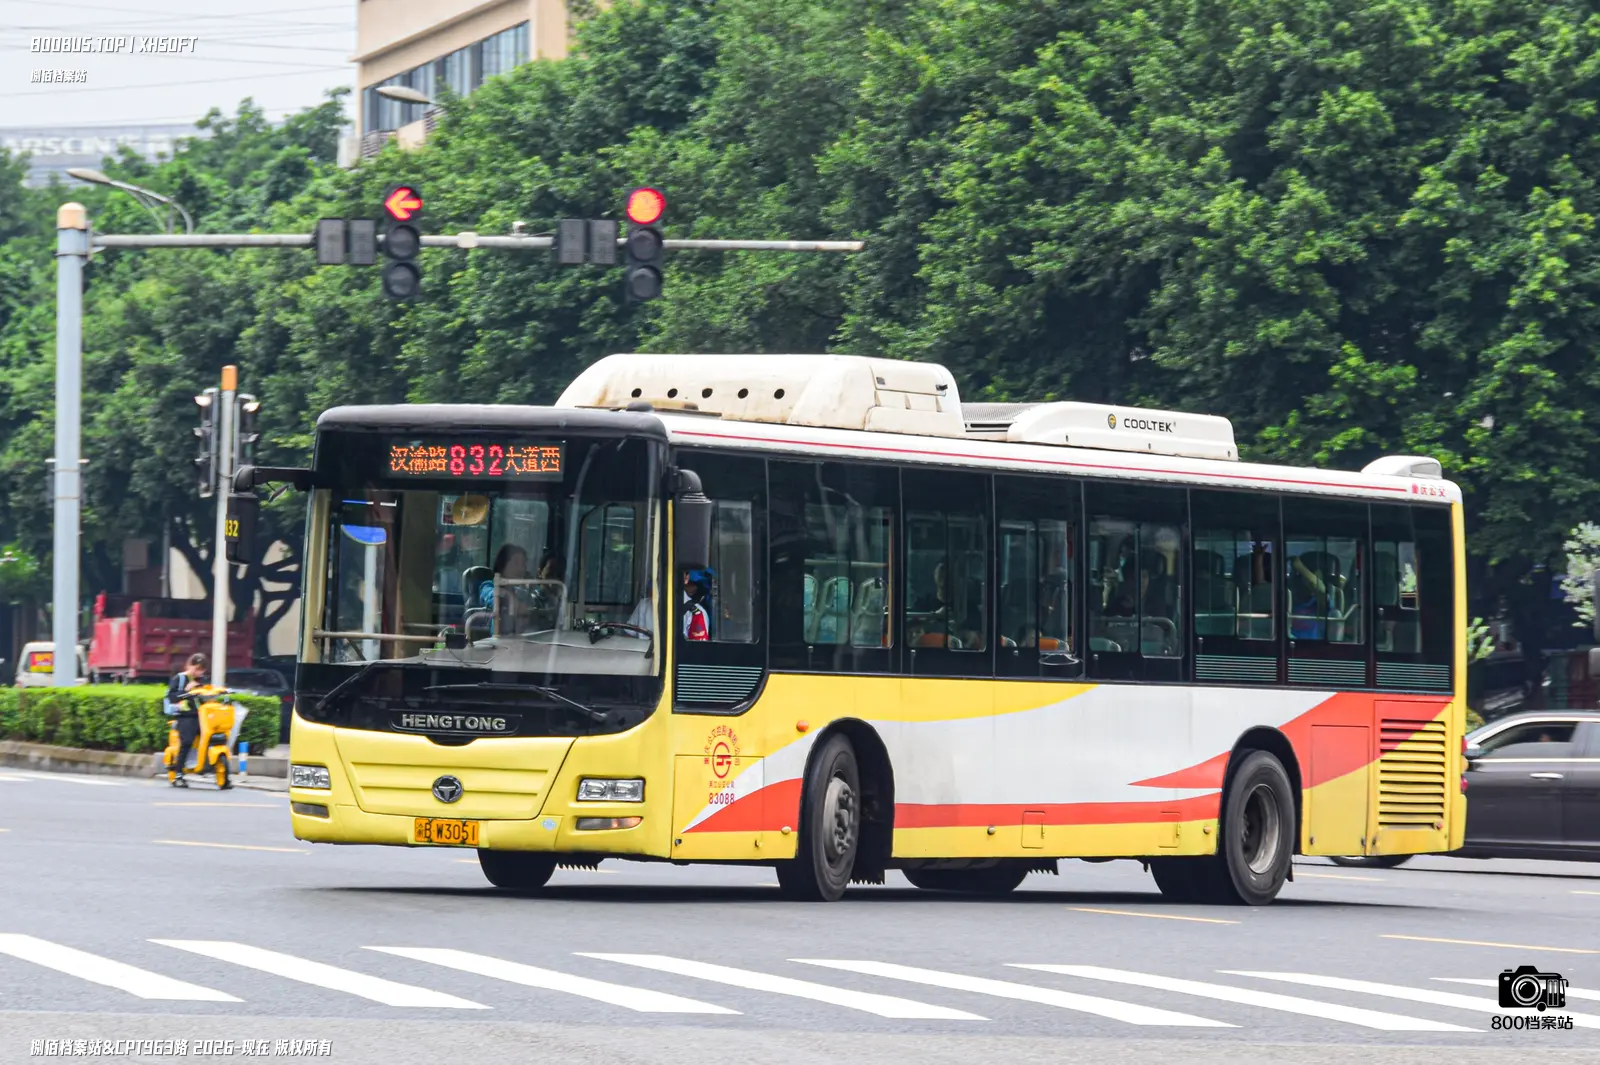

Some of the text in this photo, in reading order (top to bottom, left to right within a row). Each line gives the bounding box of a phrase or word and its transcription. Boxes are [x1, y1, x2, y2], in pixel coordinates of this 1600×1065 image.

[1123, 418, 1173, 433] COOLTEK
[449, 444, 504, 476] 832
[505, 446, 560, 474] 大道西
[402, 714, 506, 731] HENGTONG
[708, 792, 736, 805] 83088
